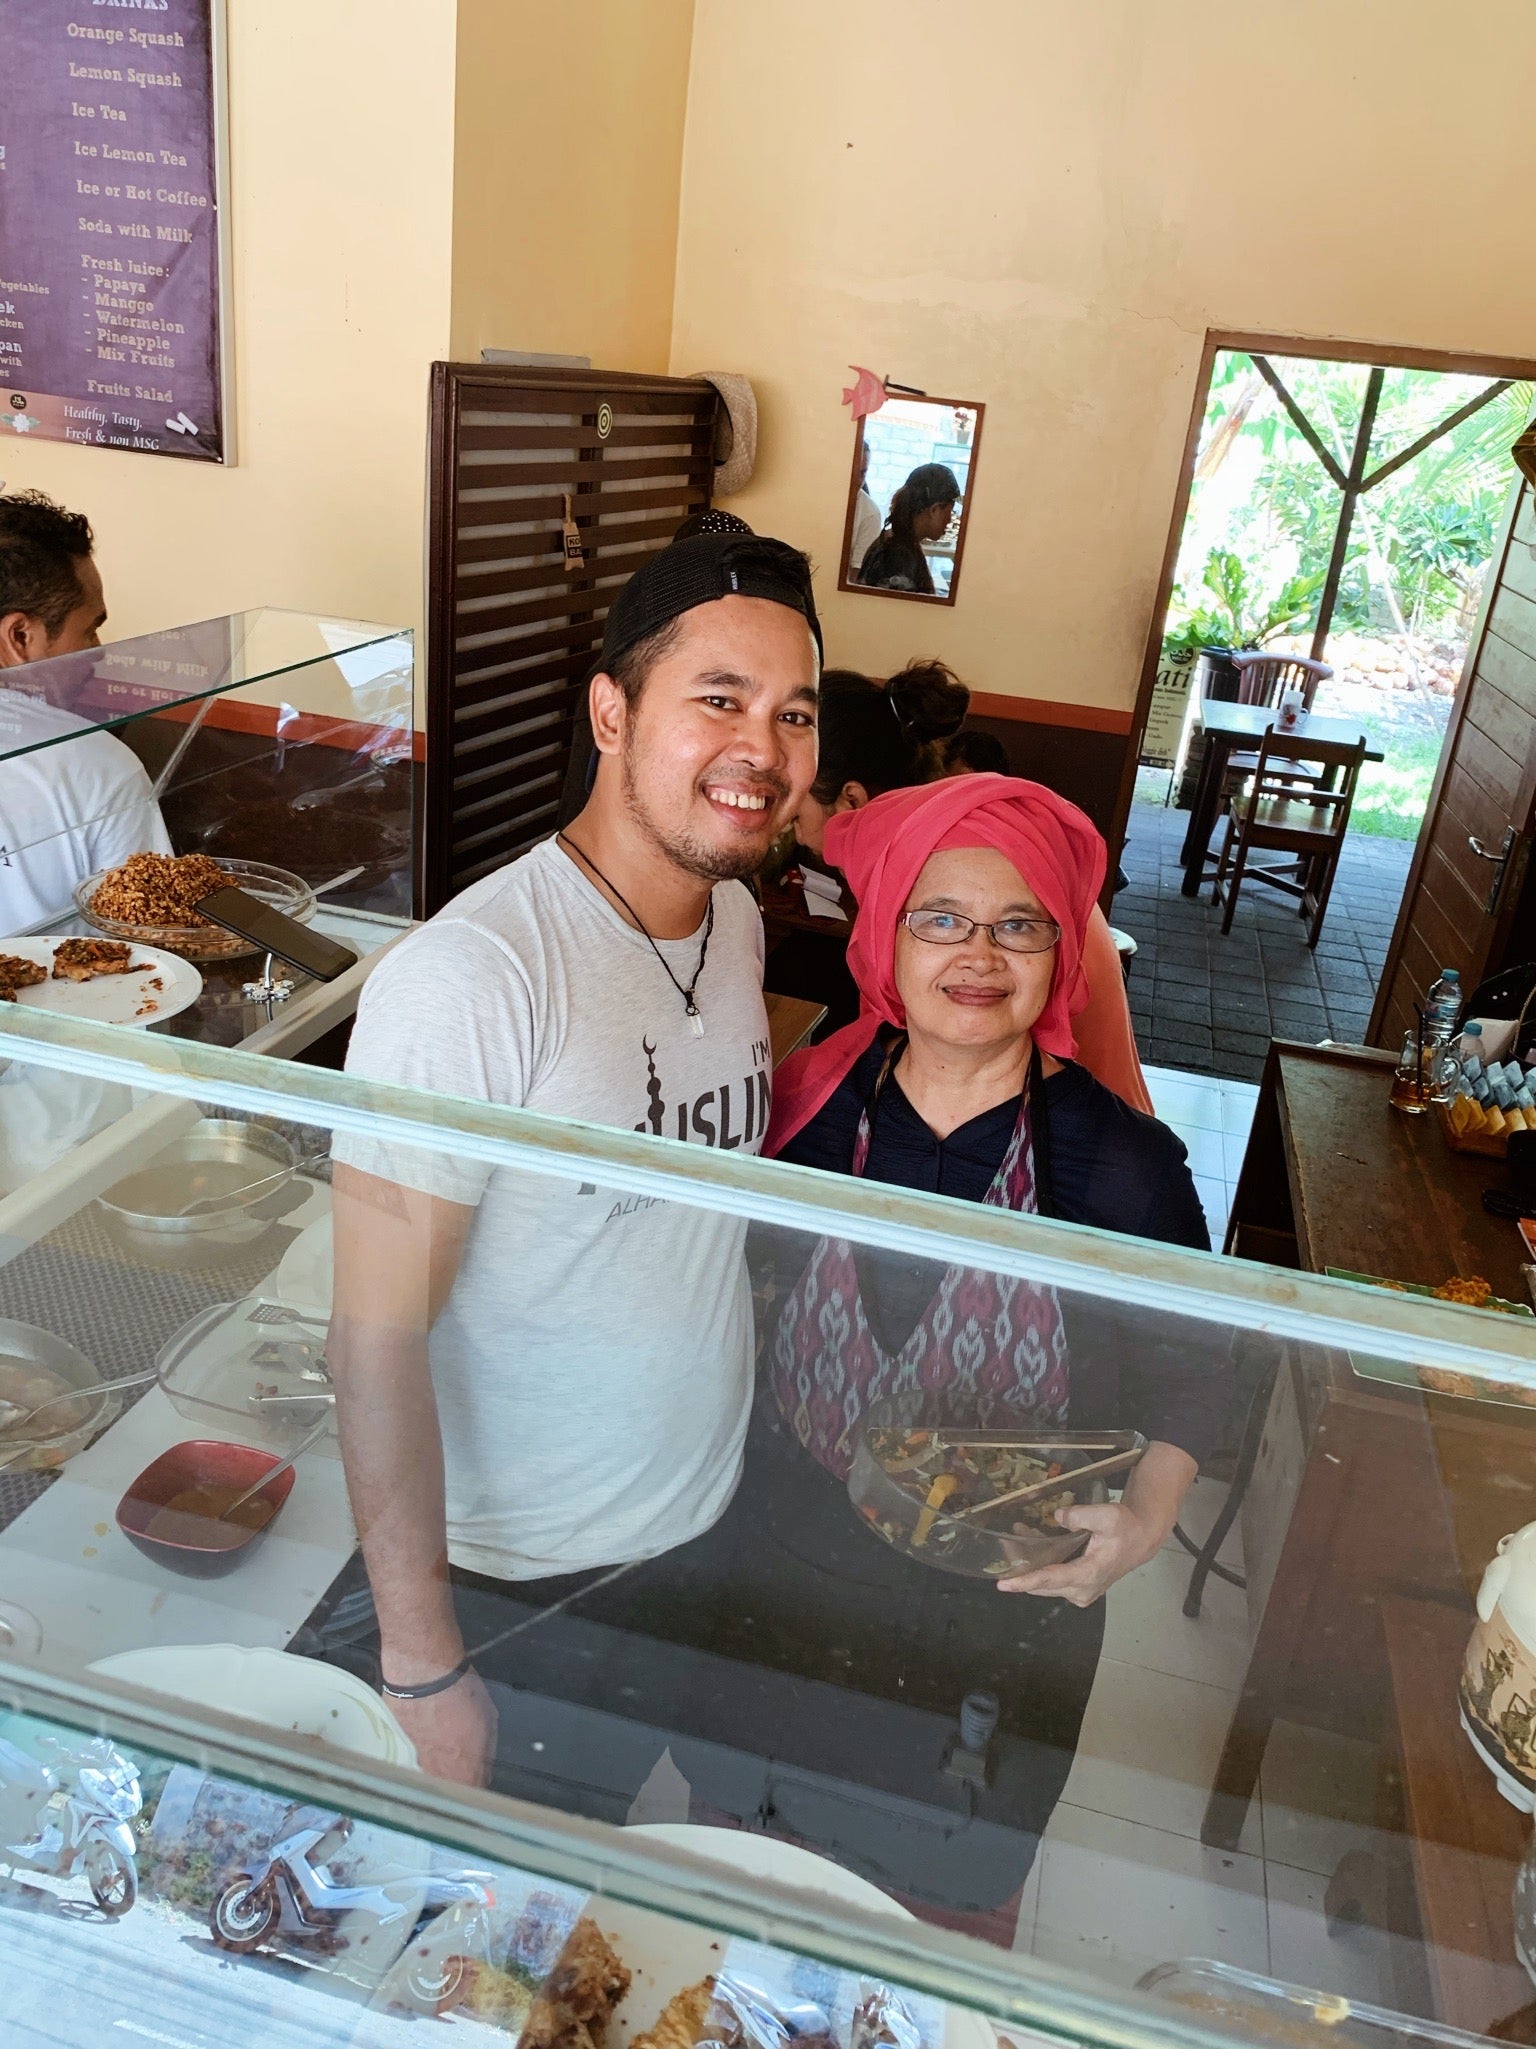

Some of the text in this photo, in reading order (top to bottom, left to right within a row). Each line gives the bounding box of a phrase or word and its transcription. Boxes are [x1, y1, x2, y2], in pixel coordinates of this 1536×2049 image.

[67, 22, 184, 48] Orange Squash
[69, 62, 182, 88] Lemon Squash
[72, 102, 127, 121] Ice Tea
[74, 141, 187, 167] Ice Lemon Tea
[76, 179, 207, 207] Ice or Hot Coffee
[78, 217, 193, 243] Soda with Milk
[81, 254, 122, 272] Fresh
[94, 273, 146, 295] Papaya
[94, 292, 154, 314] Manggo
[95, 310, 185, 334] Watermelon
[96, 328, 170, 352] Pineapple
[97, 346, 126, 362] Mix
[130, 350, 175, 368] Fruits
[87, 379, 173, 403] Fruits Salad
[65, 427, 160, 451] Fresh & non MSG
[751, 1036, 770, 1066] I'M
